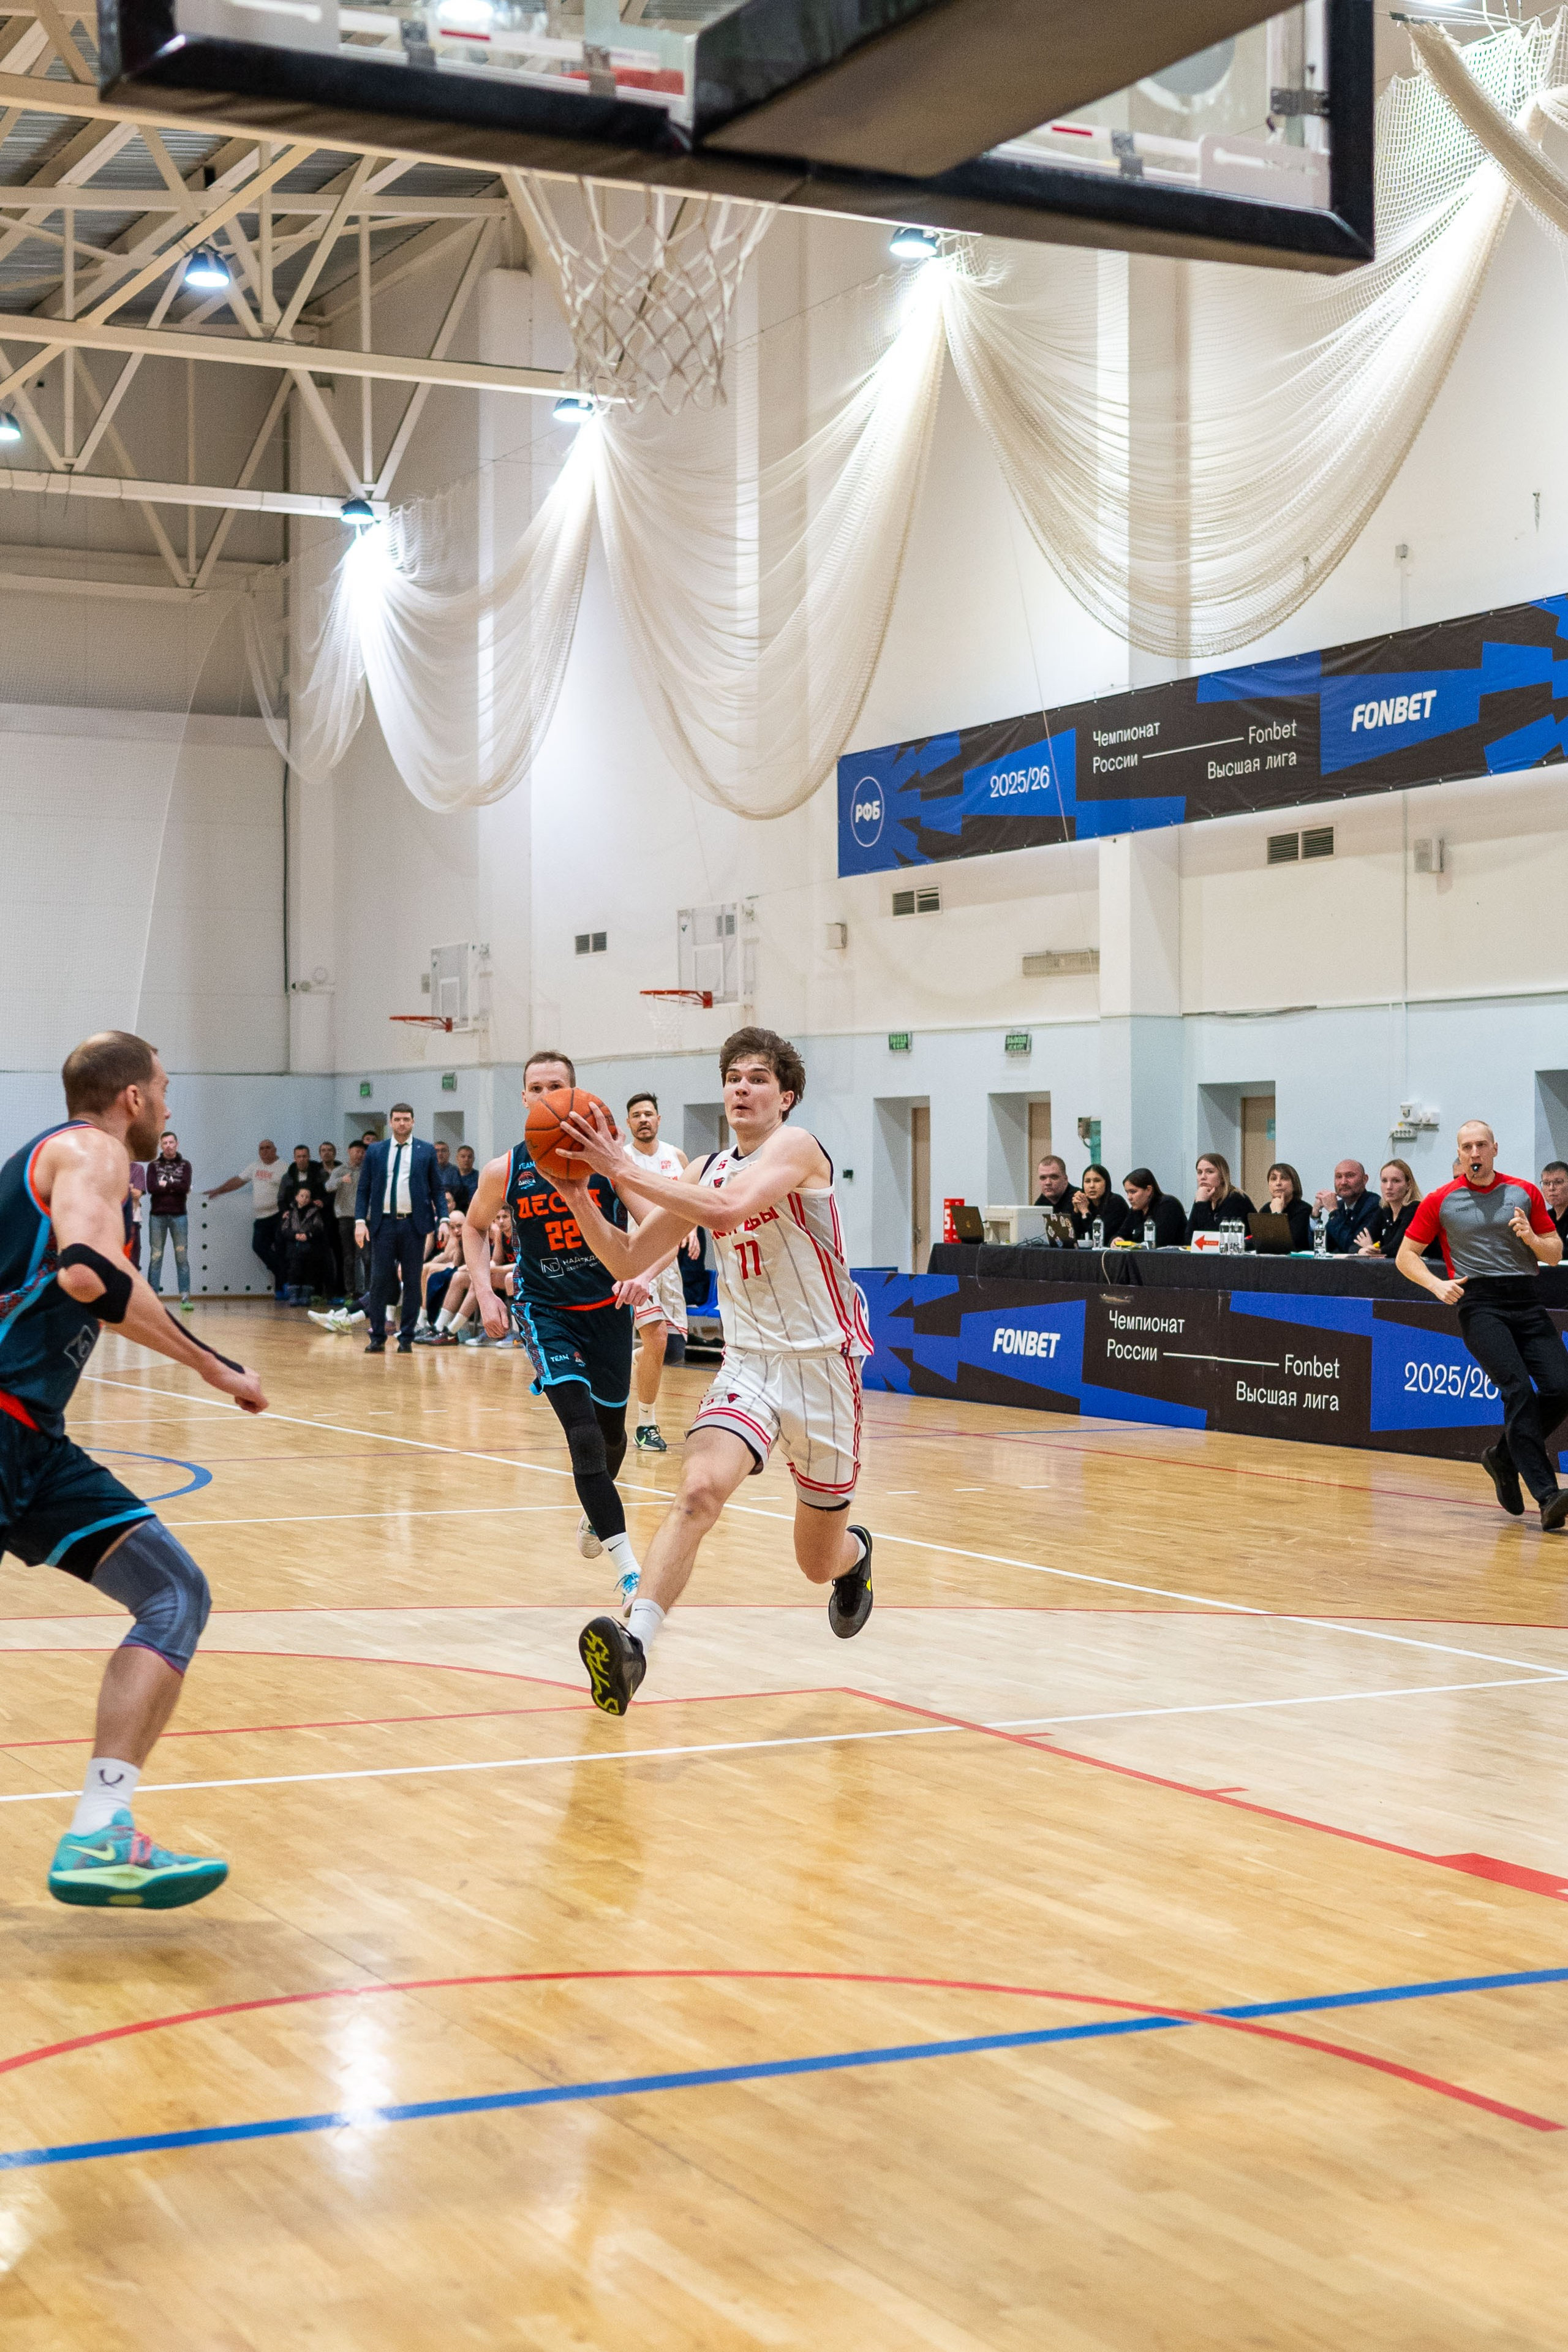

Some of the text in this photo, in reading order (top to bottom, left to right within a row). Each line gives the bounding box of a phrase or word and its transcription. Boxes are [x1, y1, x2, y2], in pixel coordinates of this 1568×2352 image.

[1351, 690, 1437, 732] FONBET
[1093, 722, 1161, 747] Чемпионат
[1248, 719, 1297, 745] Fonbet
[1092, 754, 1139, 774] России
[1207, 751, 1297, 780] Высшая лига
[990, 766, 1050, 798] 2025/26
[855, 801, 881, 823] РФБ
[545, 1219, 582, 1251] 22
[1109, 1310, 1185, 1333] Чемпионат
[992, 1328, 1061, 1359] FONBET
[1106, 1339, 1158, 1361] России
[1285, 1354, 1340, 1379] Fonbet
[1236, 1381, 1340, 1411] Высшая лига
